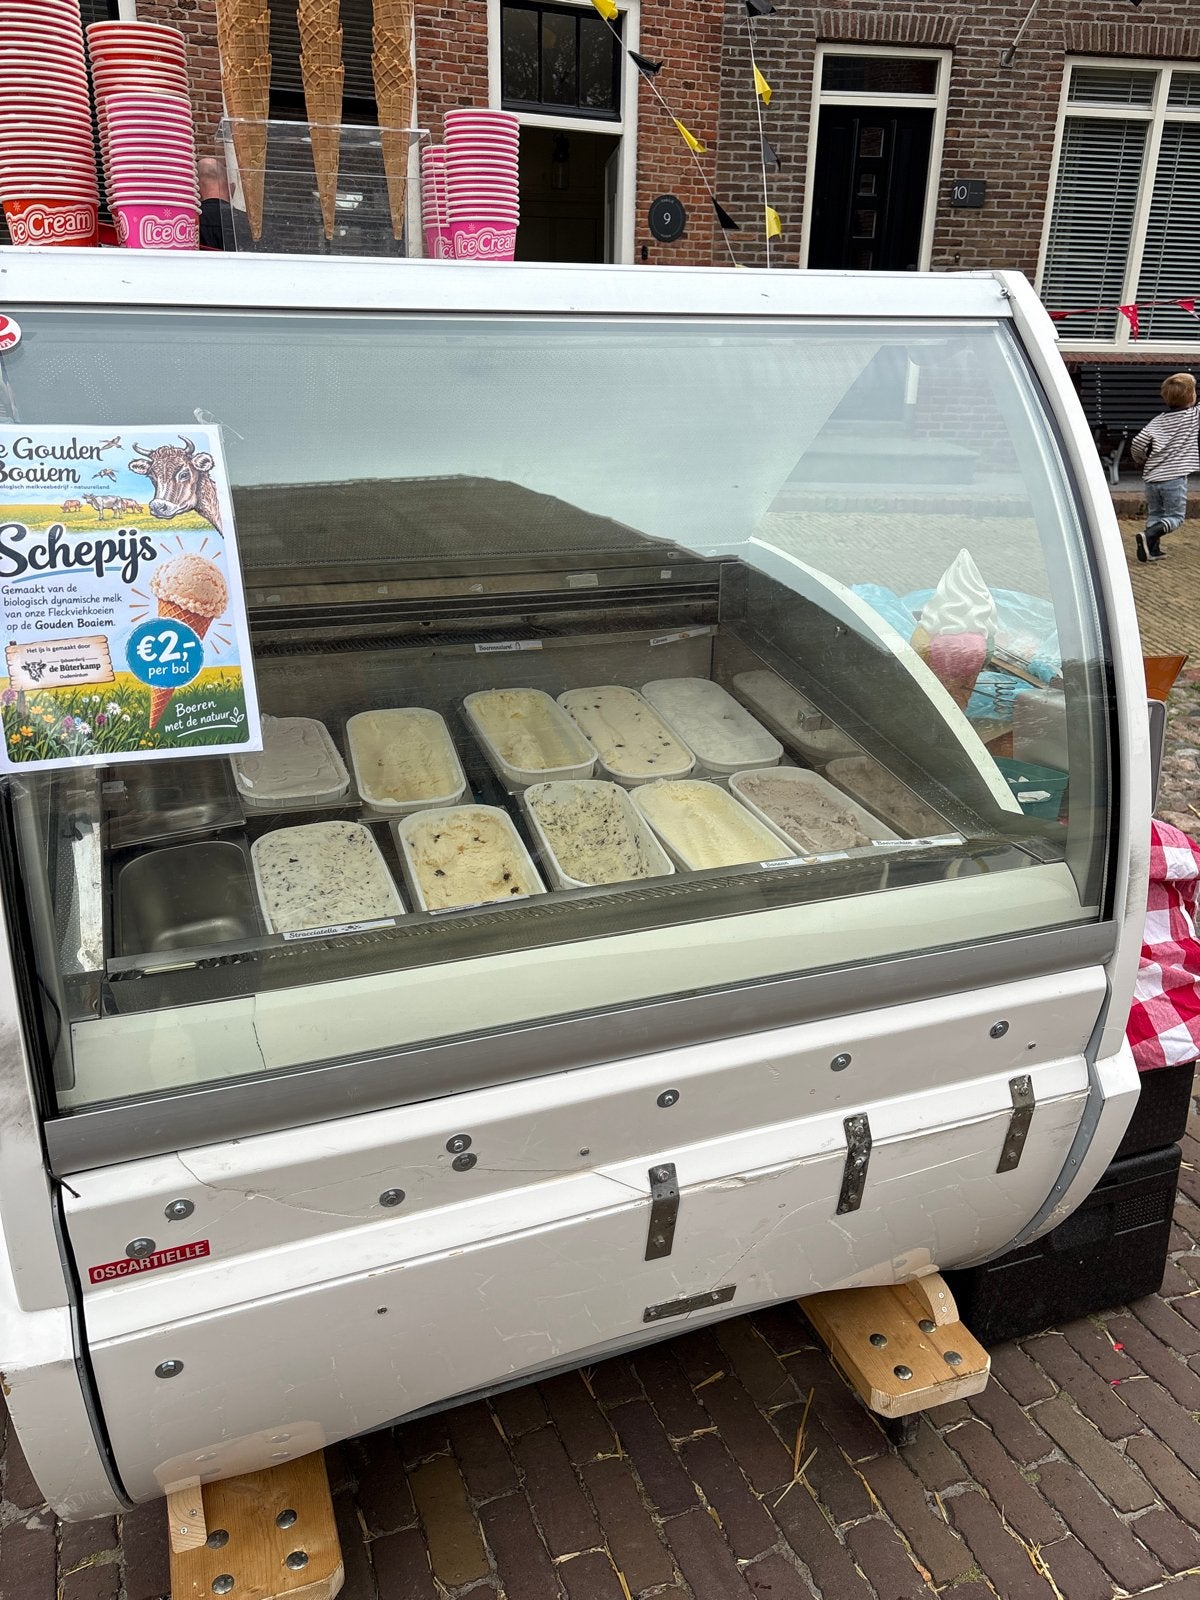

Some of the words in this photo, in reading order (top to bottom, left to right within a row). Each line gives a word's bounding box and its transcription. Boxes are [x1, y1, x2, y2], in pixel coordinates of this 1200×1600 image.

[953, 185, 968, 200] 10
[28, 212, 92, 237] Cream
[663, 212, 671, 225] 9
[145, 221, 173, 242] Ice
[457, 235, 477, 256] Ice
[12, 436, 103, 462] Gouden
[0, 523, 158, 584] Schepijs
[1, 584, 45, 595] Gemaakt
[66, 583, 77, 592] de
[3, 596, 49, 609] biologisch
[50, 594, 101, 608] dynamische
[103, 593, 122, 602] melk
[5, 610, 22, 619] van
[24, 610, 46, 619] onze
[48, 607, 114, 617] Fleckviehkoeien
[6, 623, 19, 633] op
[20, 620, 32, 631] de
[35, 619, 74, 630] Gouden
[77, 618, 116, 628] Boaiem.
[52, 645, 76, 653] gemaakt
[77, 643, 91, 651] door
[136, 630, 196, 663] €2,-
[48, 664, 59, 673] de
[60, 662, 101, 672] Bûterkamp
[148, 665, 169, 680] per
[172, 661, 190, 675] bol
[175, 699, 217, 718] Boeren
[165, 720, 184, 733] met
[186, 714, 199, 727] de
[200, 710, 231, 725] natuur
[288, 927, 338, 940] Stracciatella
[93, 1243, 205, 1280] OSCARTIELLE
